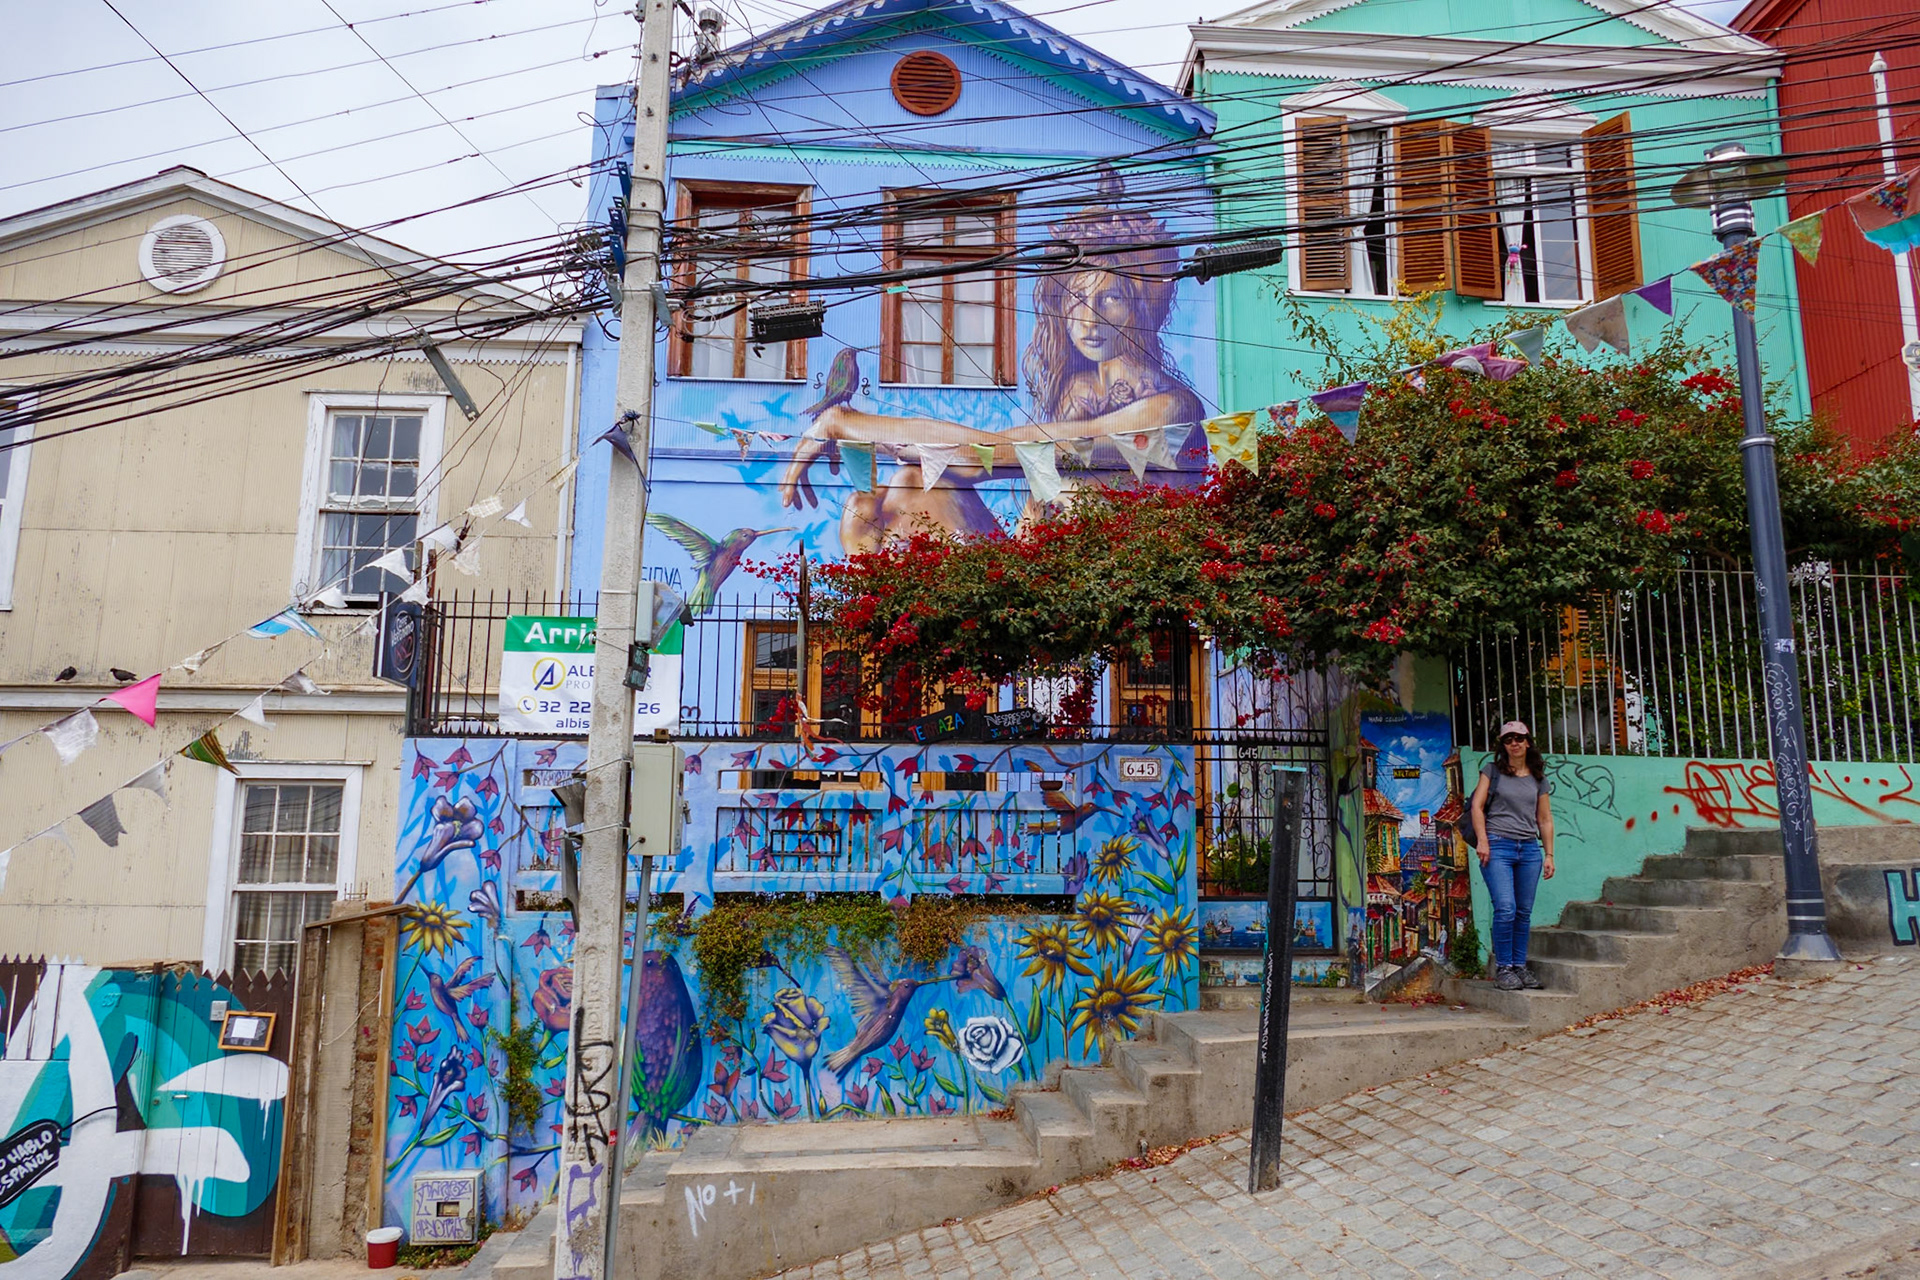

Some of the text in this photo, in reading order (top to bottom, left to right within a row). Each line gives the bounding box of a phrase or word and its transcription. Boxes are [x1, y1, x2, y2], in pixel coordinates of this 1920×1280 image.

[539, 701, 560, 712] 32
[1238, 746, 1258, 759] 645
[1126, 763, 1155, 776] 645
[7, 1130, 53, 1164] HABLO
